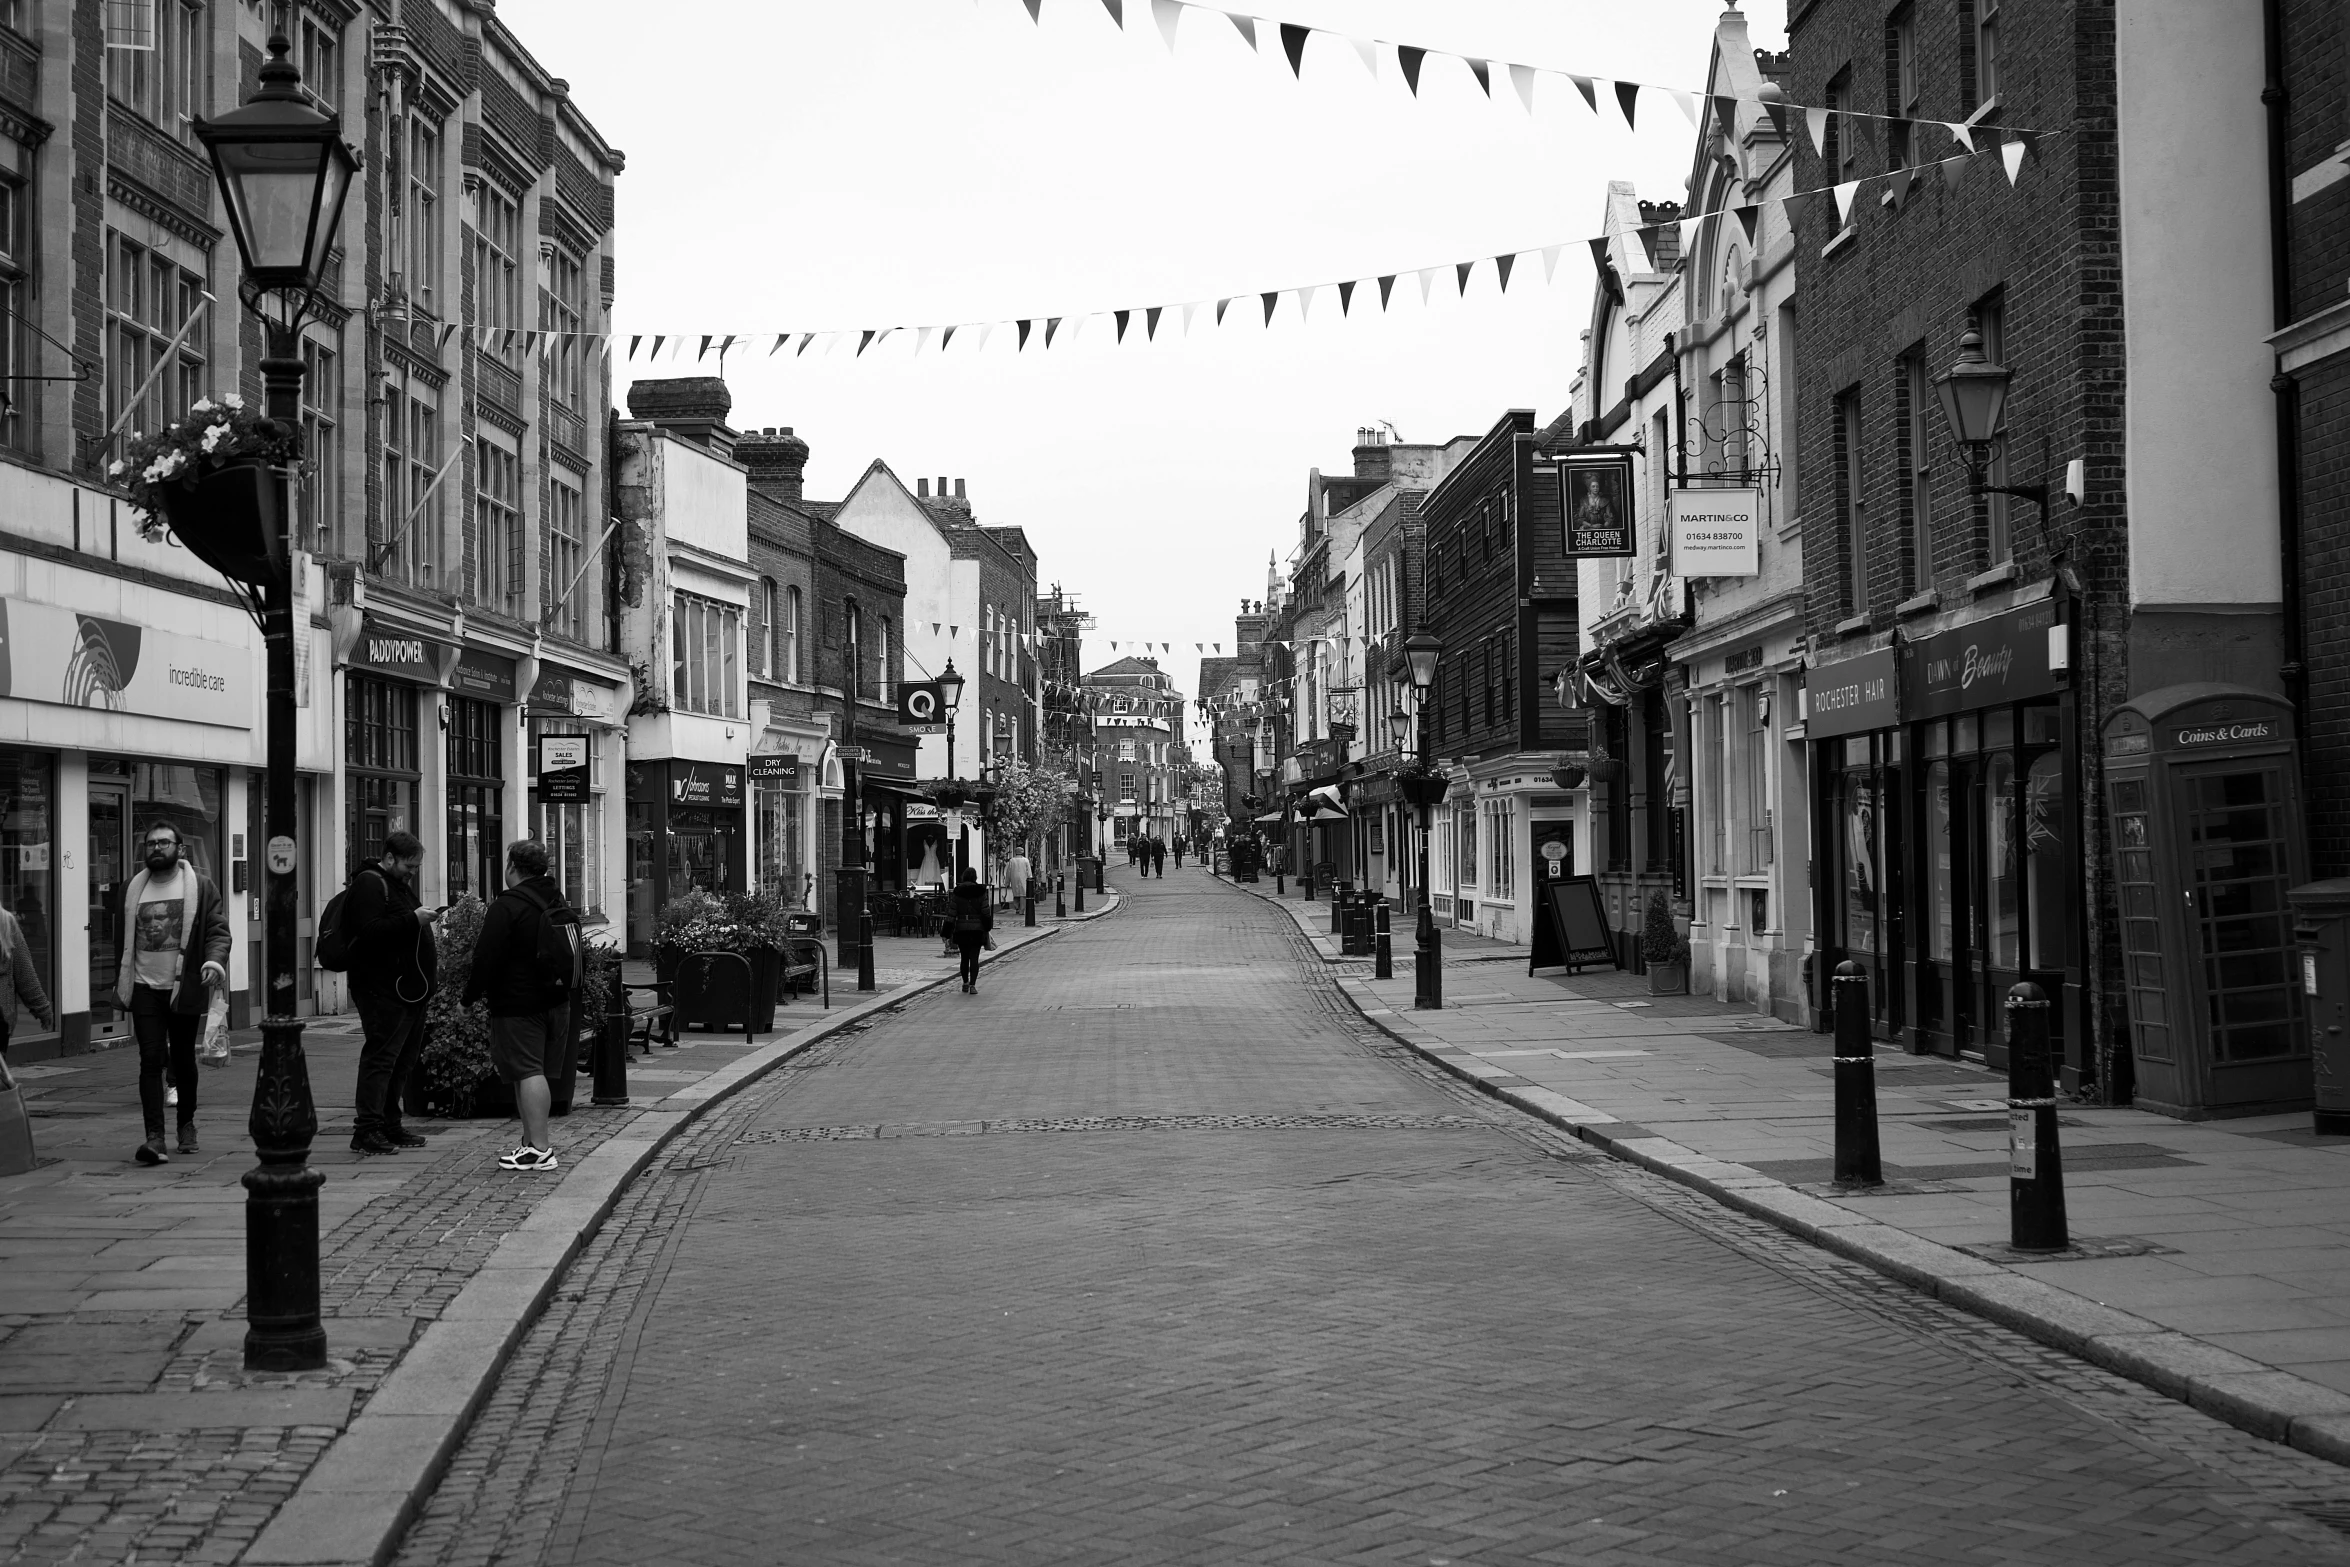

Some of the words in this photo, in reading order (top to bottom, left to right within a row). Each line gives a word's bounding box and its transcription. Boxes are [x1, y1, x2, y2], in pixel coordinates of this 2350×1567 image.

[1680, 514, 1749, 522] MARTIN&CO
[1576, 531, 1592, 539] THE
[1593, 531, 1620, 539] QUEEN
[1575, 538, 1622, 546] CHARLOTTE
[369, 640, 423, 663] PADDYPOWER
[1927, 657, 1951, 684] DAWN
[1961, 644, 2013, 690] Beauty
[169, 663, 208, 689] incredible
[208, 675, 225, 692] care
[1815, 684, 1860, 713] ROCHESTER
[1865, 678, 1885, 702] HAIR
[2178, 727, 2215, 744] Coins
[2216, 728, 2228, 741] &
[2230, 723, 2269, 738] Cards
[765, 759, 781, 767] DRY
[753, 768, 795, 776] CLEANING
[907, 806, 926, 816] Kiss
